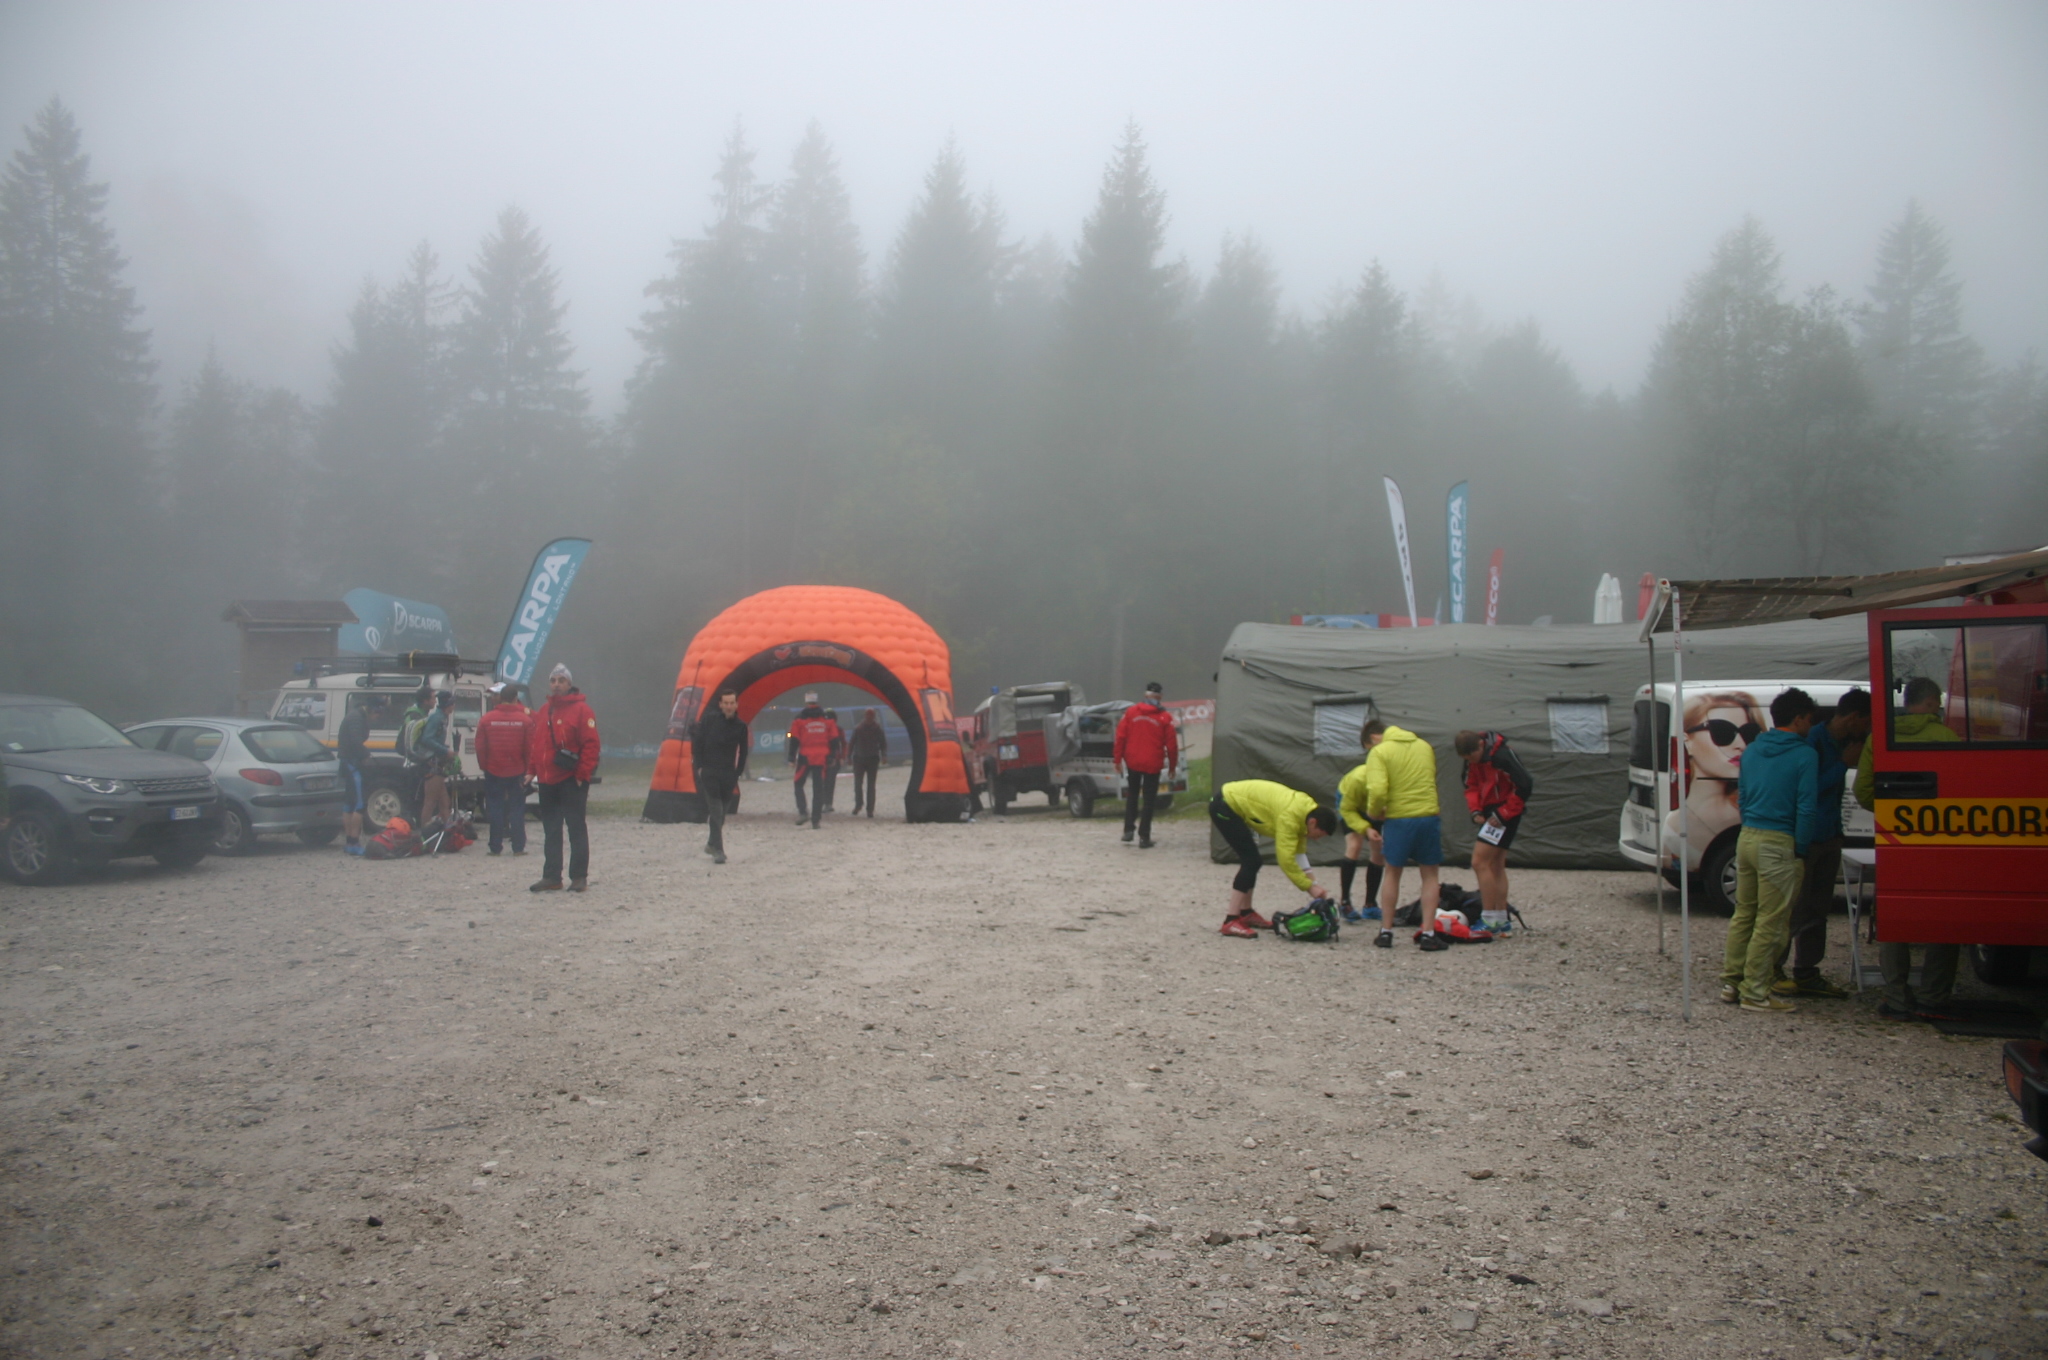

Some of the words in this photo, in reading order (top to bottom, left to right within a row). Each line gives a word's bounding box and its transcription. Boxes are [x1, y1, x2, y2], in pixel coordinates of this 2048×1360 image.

[1450, 496, 1463, 623] SCARPA
[408, 614, 443, 633] SCARPA
[501, 553, 572, 682] CARPA
[1893, 805, 2048, 837] SOCCOR
